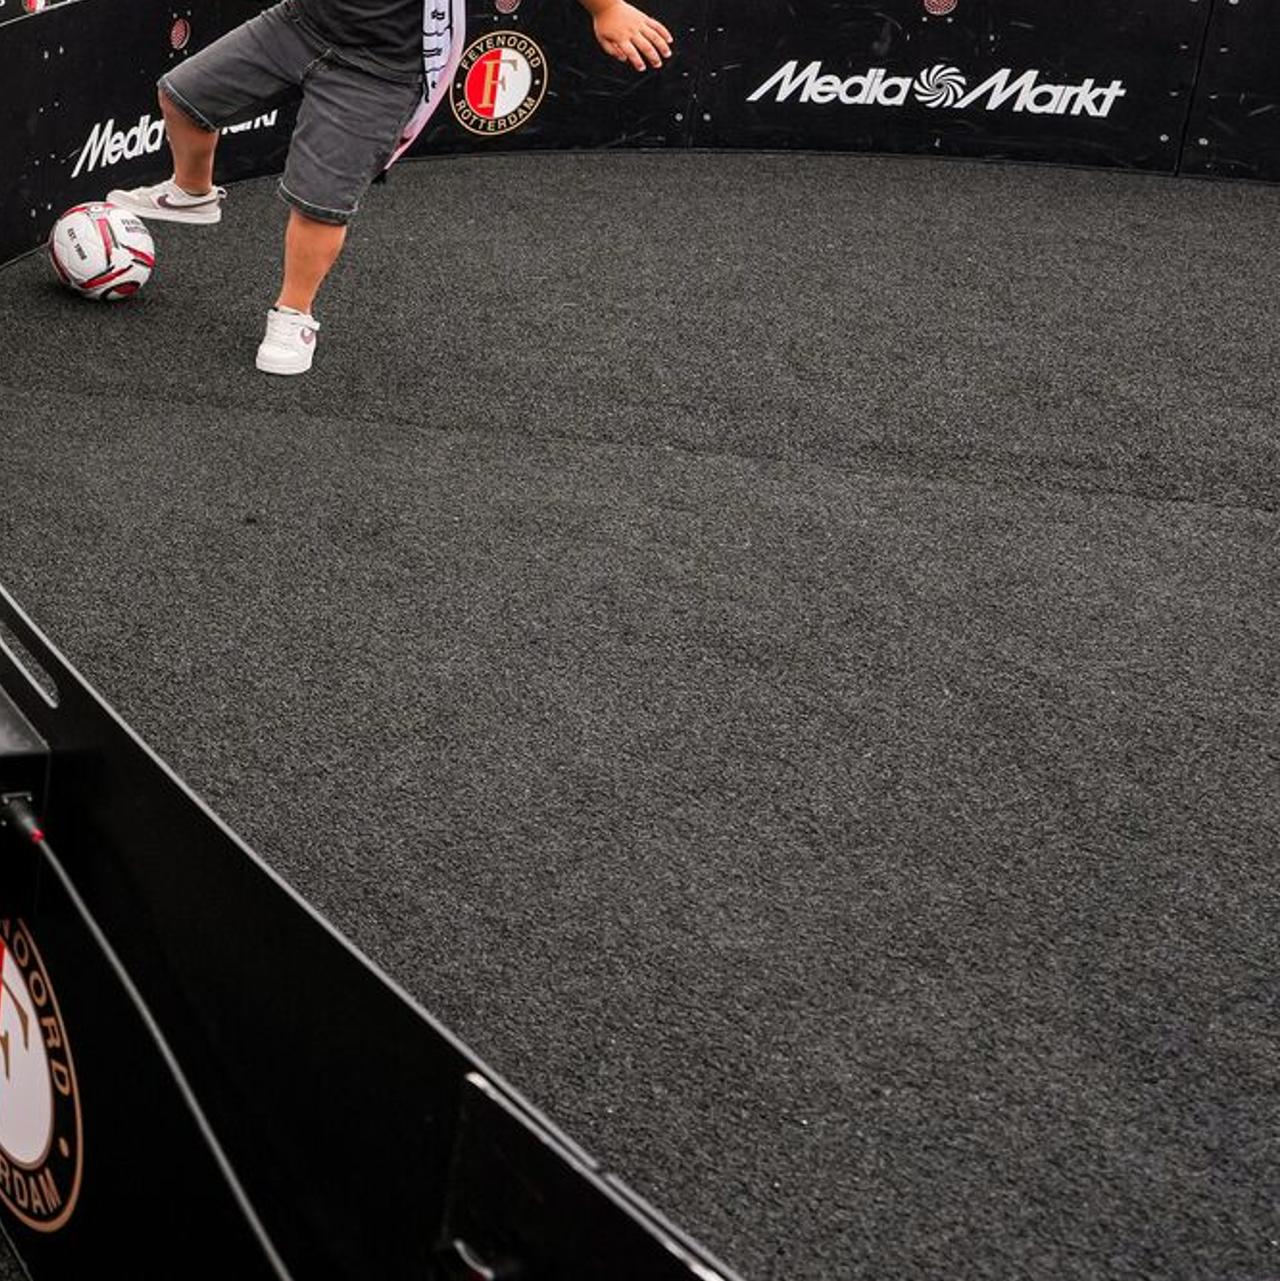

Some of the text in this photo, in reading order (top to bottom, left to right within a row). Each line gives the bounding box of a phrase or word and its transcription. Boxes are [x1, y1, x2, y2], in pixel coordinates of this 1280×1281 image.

[461, 35, 541, 70] FEYENOORD
[746, 60, 1126, 117] Media Markt
[456, 96, 536, 131] ROTTERDAM
[71, 115, 165, 178] Media
